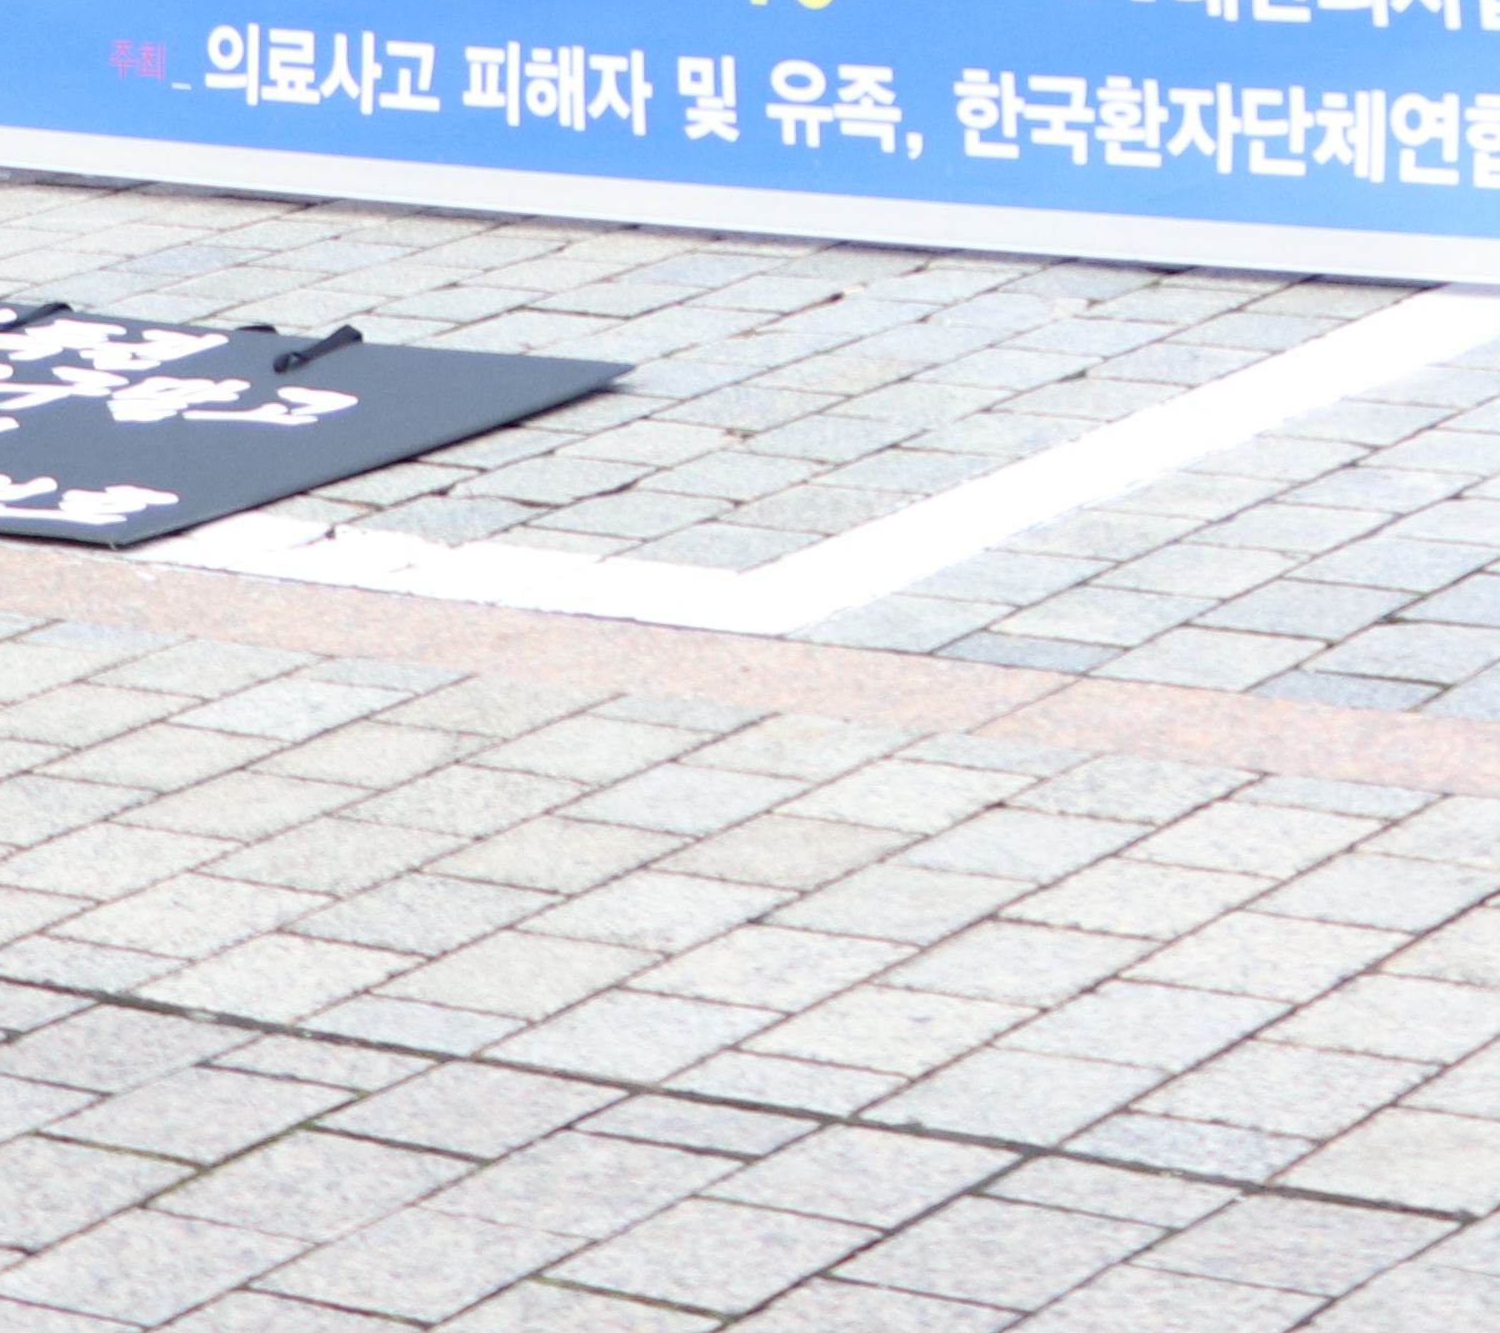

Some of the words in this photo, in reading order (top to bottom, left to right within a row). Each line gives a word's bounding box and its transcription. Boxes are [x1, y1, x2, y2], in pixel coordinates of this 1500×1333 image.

[204, 21, 441, 116] 의료사고
[462, 43, 653, 135] 피해자
[676, 55, 740, 141] 및
[764, 61, 924, 161] 유족,
